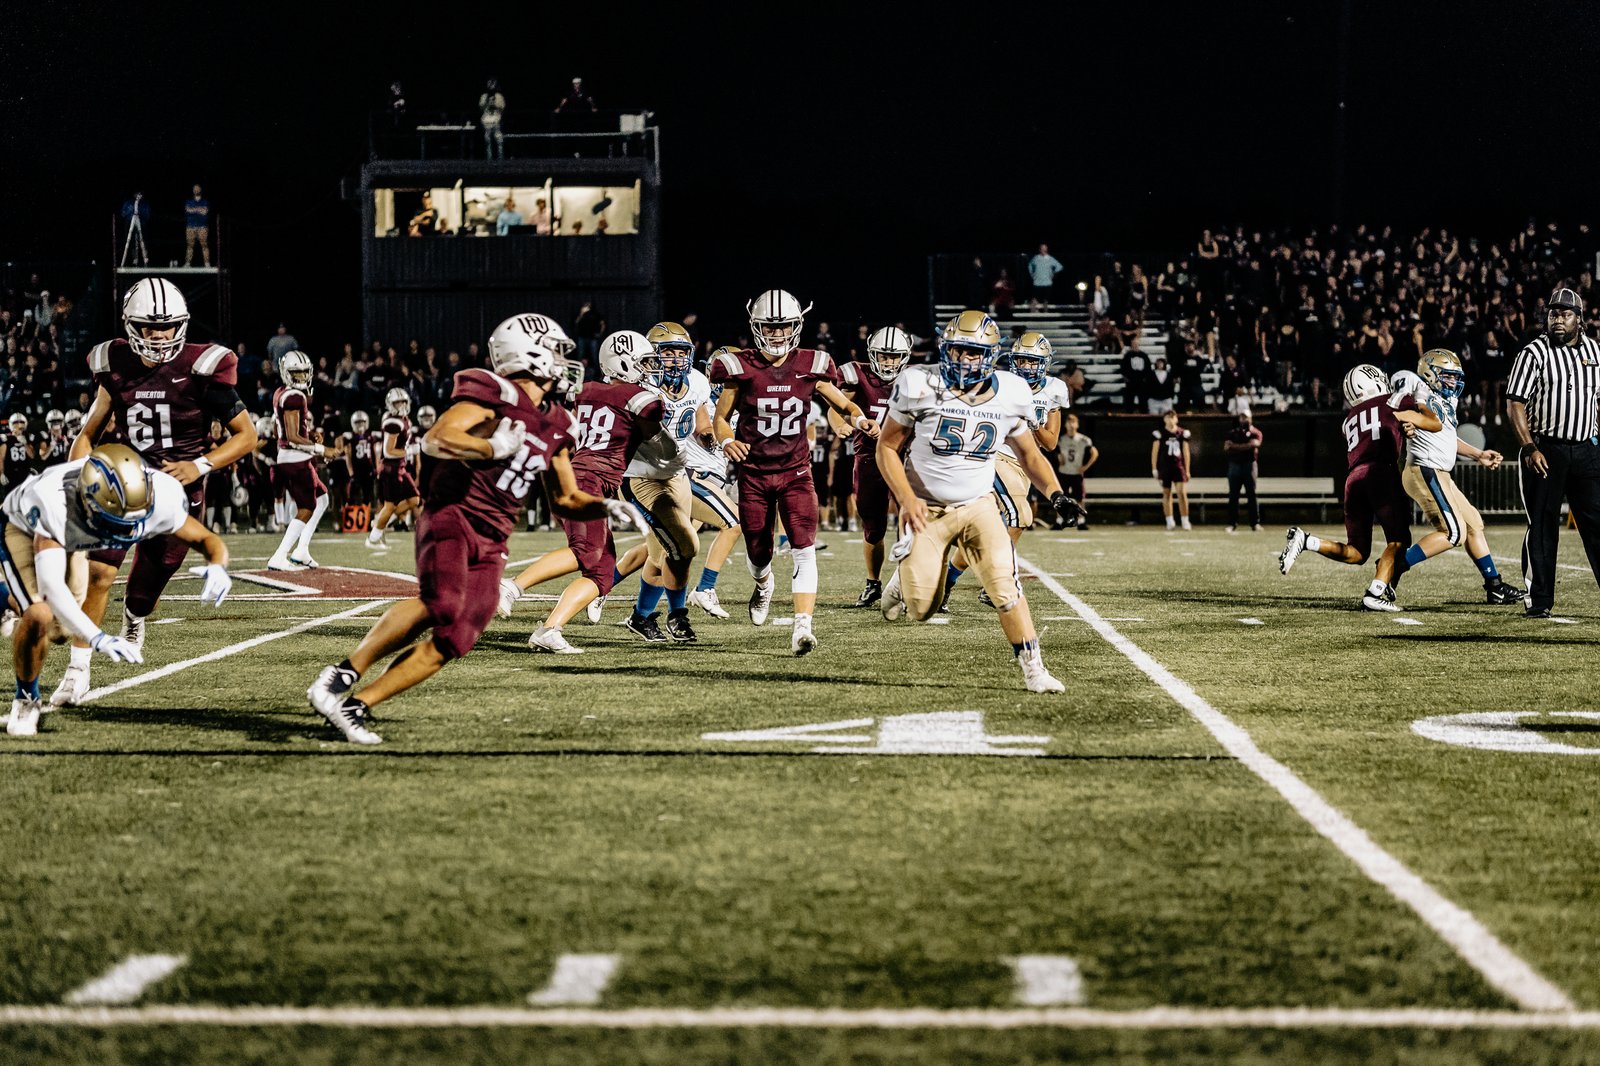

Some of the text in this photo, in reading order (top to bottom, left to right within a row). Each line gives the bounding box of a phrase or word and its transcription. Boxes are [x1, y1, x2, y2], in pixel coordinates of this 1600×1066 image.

[135, 390, 166, 399] WHEATON
[766, 385, 792, 393] WHEATON
[757, 396, 804, 438] 52
[940, 407, 1001, 420] AURORA CENTRAL
[126, 401, 174, 452] 61
[934, 415, 998, 462] 52
[344, 506, 366, 530] 50
